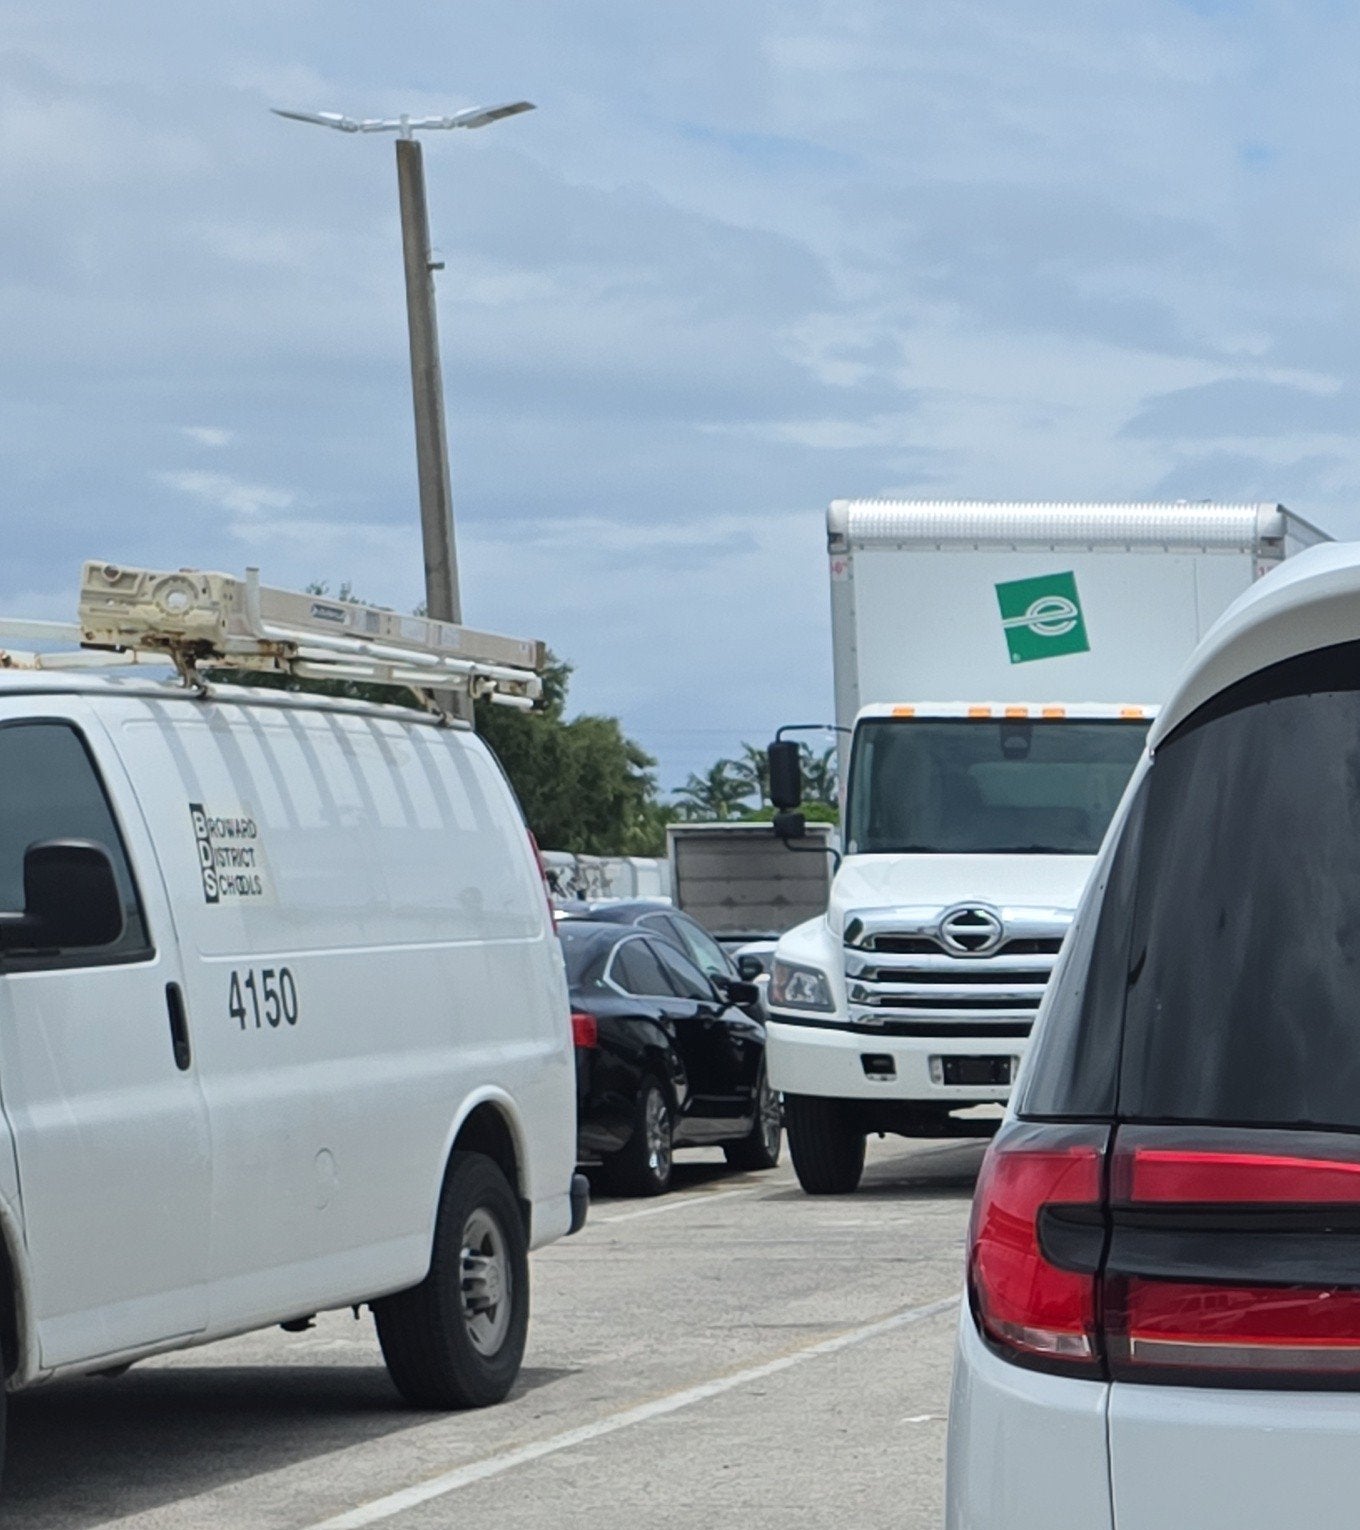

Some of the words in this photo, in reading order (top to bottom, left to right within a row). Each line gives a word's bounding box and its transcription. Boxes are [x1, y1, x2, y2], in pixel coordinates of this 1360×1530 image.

[192, 811, 258, 839] BROWARD
[199, 840, 255, 868] DISTRICT
[204, 868, 262, 897] SCHOOLS
[229, 967, 298, 1030] 4150
